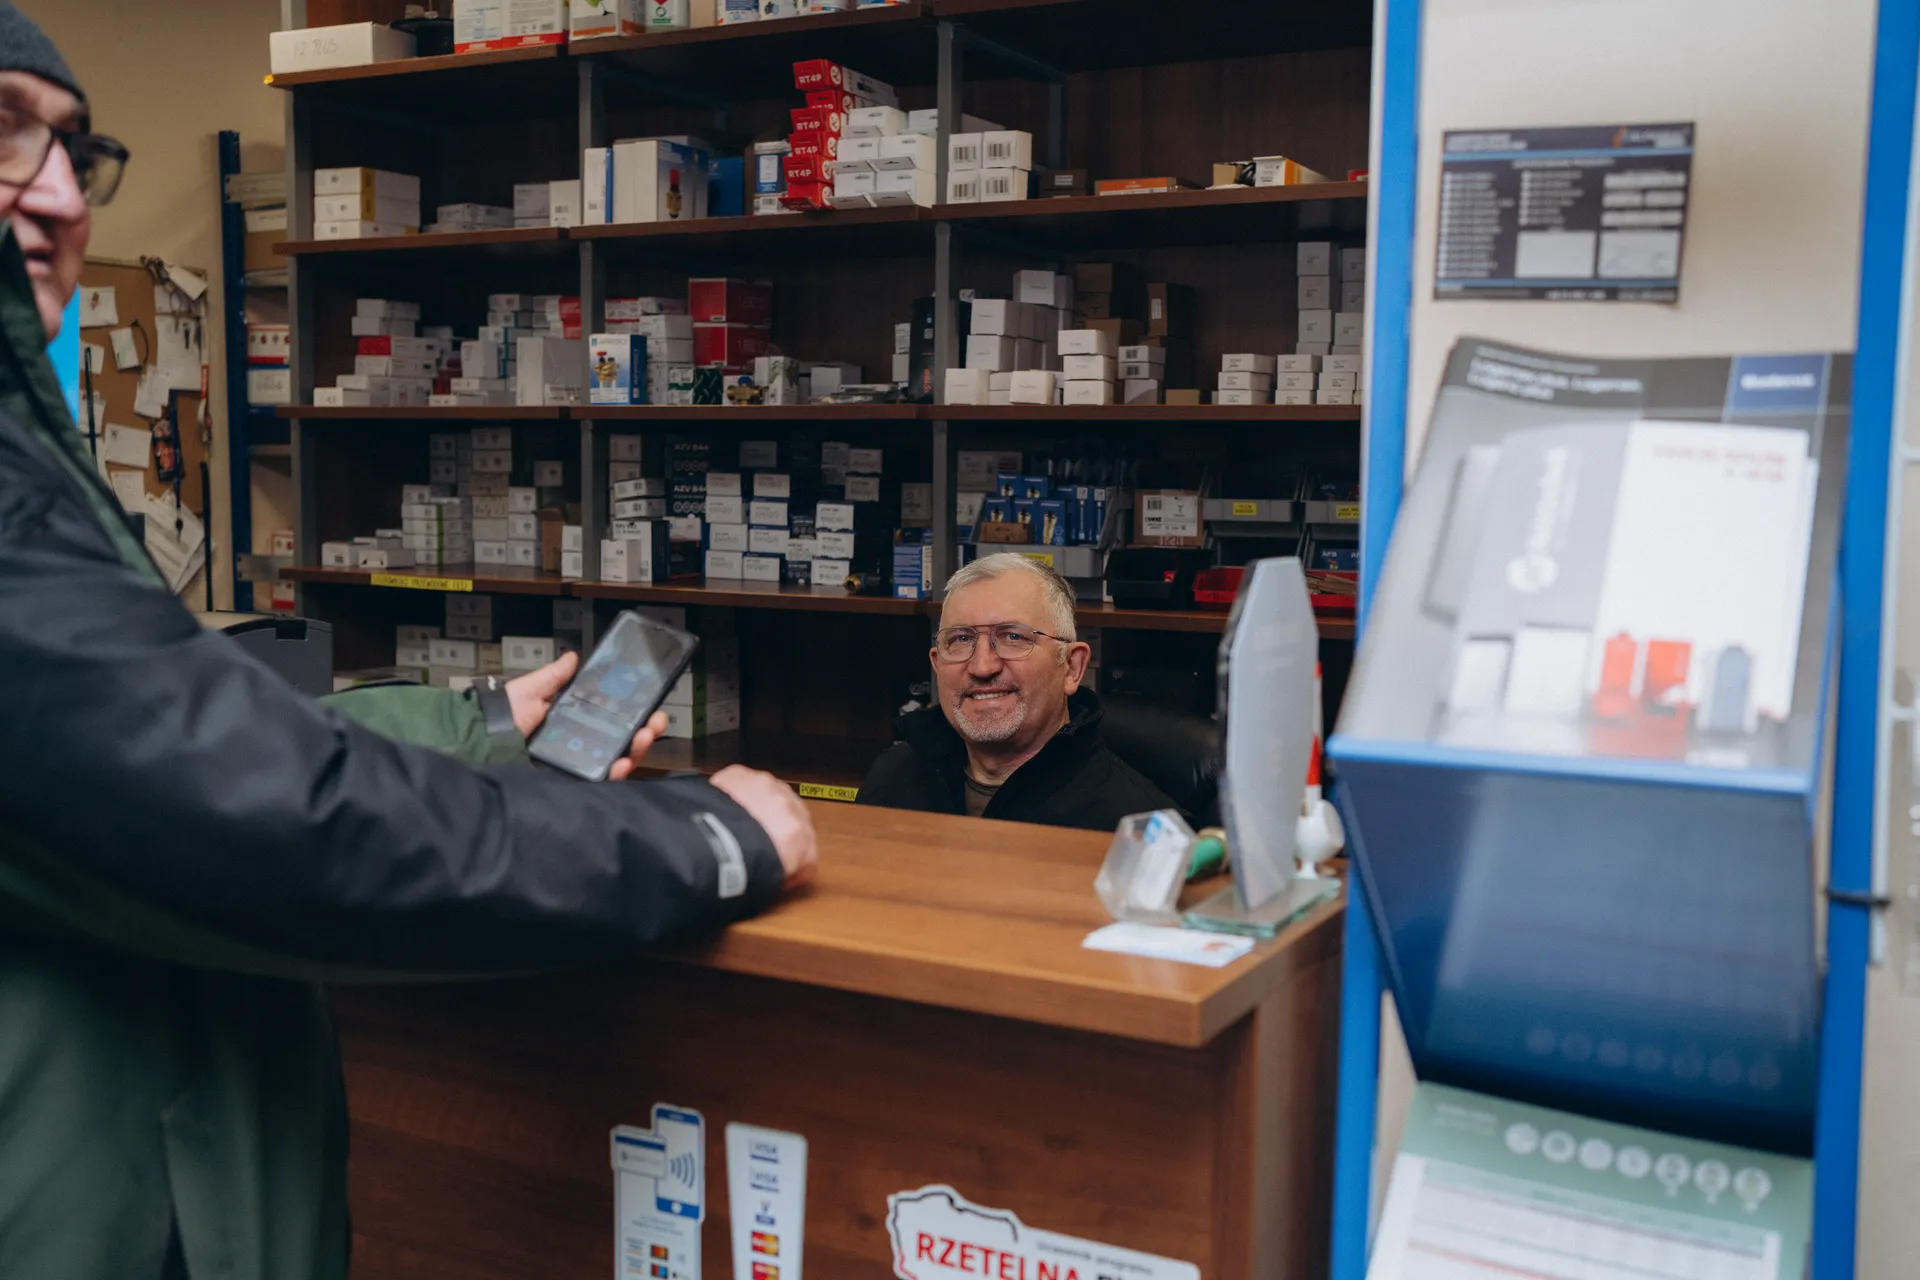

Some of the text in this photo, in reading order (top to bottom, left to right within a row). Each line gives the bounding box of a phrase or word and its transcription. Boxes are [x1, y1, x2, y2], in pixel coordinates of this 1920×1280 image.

[798, 73, 823, 84] RT4P
[796, 120, 821, 131] RT4P
[794, 146, 819, 156] RT4P
[788, 169, 812, 178] RT4P
[801, 785, 824, 796] POMPY
